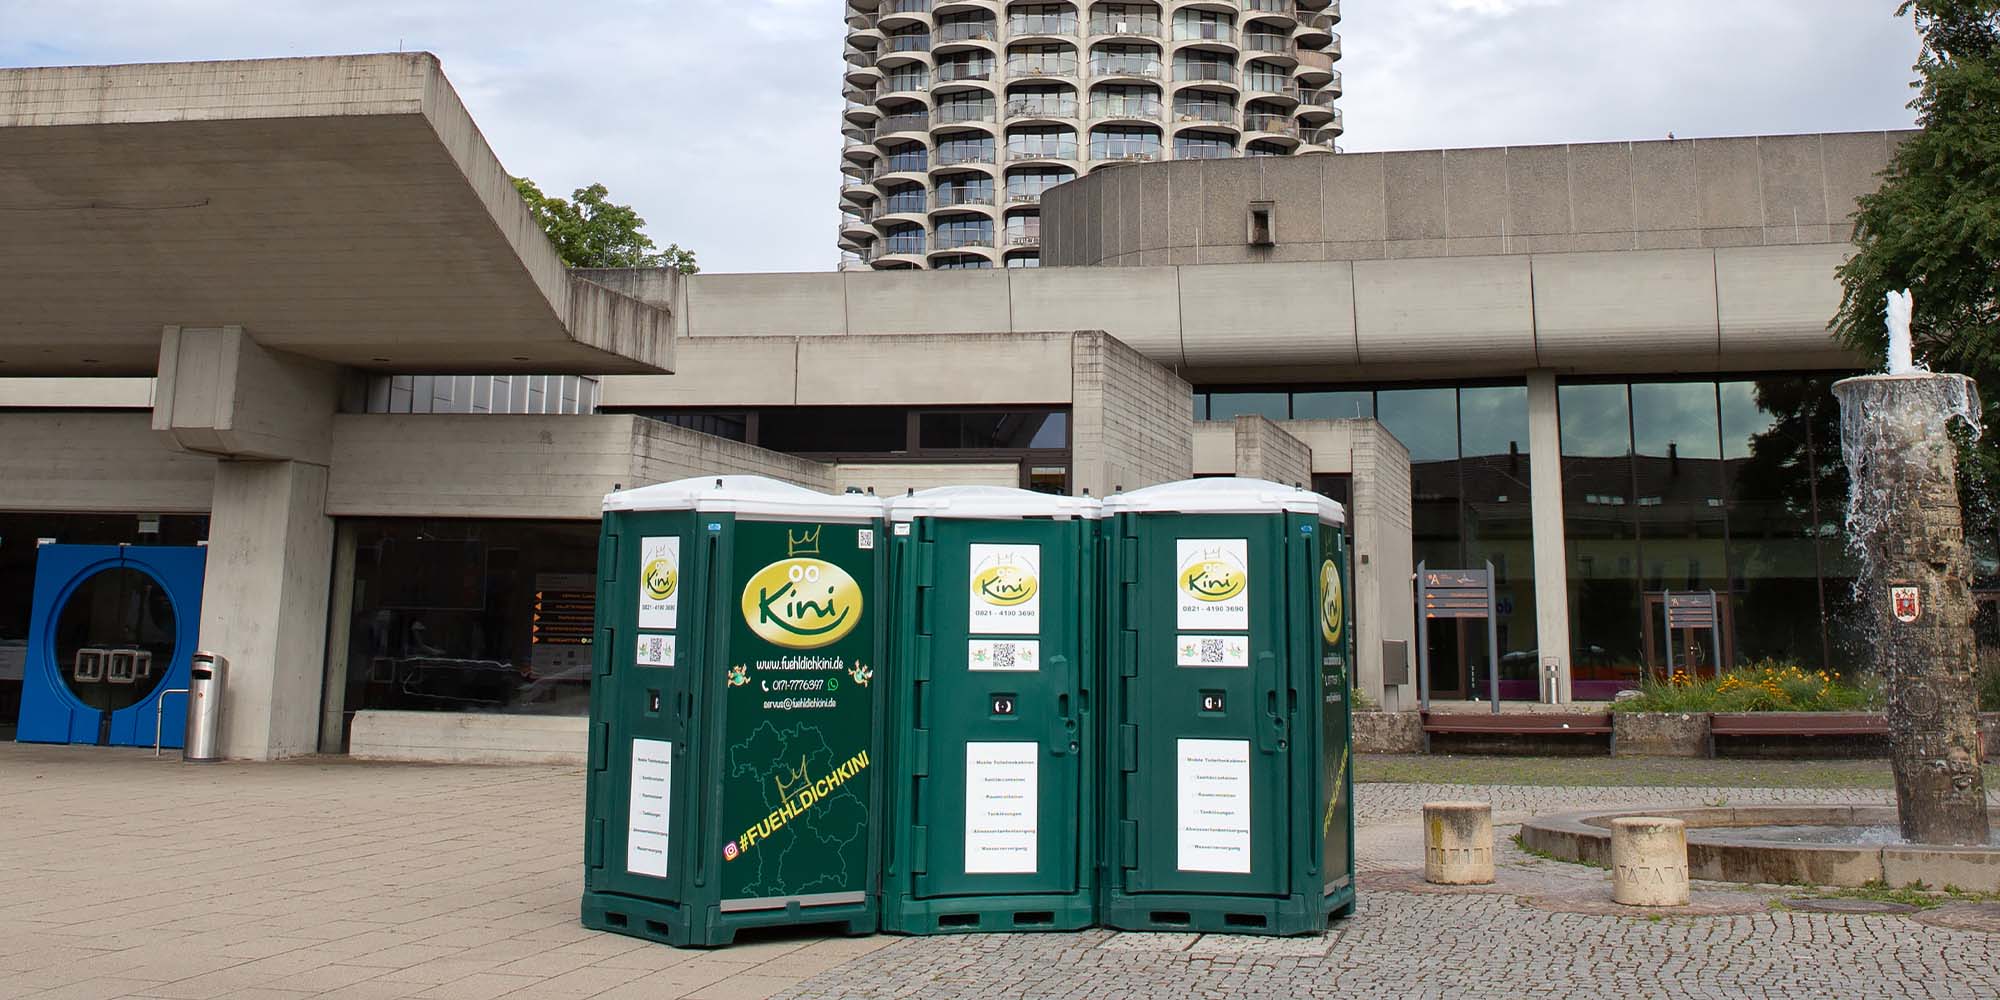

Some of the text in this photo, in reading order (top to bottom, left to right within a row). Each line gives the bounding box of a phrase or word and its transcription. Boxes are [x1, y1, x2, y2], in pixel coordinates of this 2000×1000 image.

[647, 569, 674, 595] Kini
[982, 575, 1031, 601] Kini
[1189, 571, 1238, 596] Kini
[759, 581, 850, 636] Kini
[975, 609, 992, 617] 0821
[1018, 609, 1035, 617] 3690
[1182, 605, 1200, 613] 0821
[1206, 605, 1224, 613] 4190
[1226, 605, 1244, 613] 3690
[756, 656, 844, 672] www.fuehldichkini.de
[772, 679, 824, 691] 0171-7776397
[738, 749, 870, 853] #FUEHLDICHKINI
